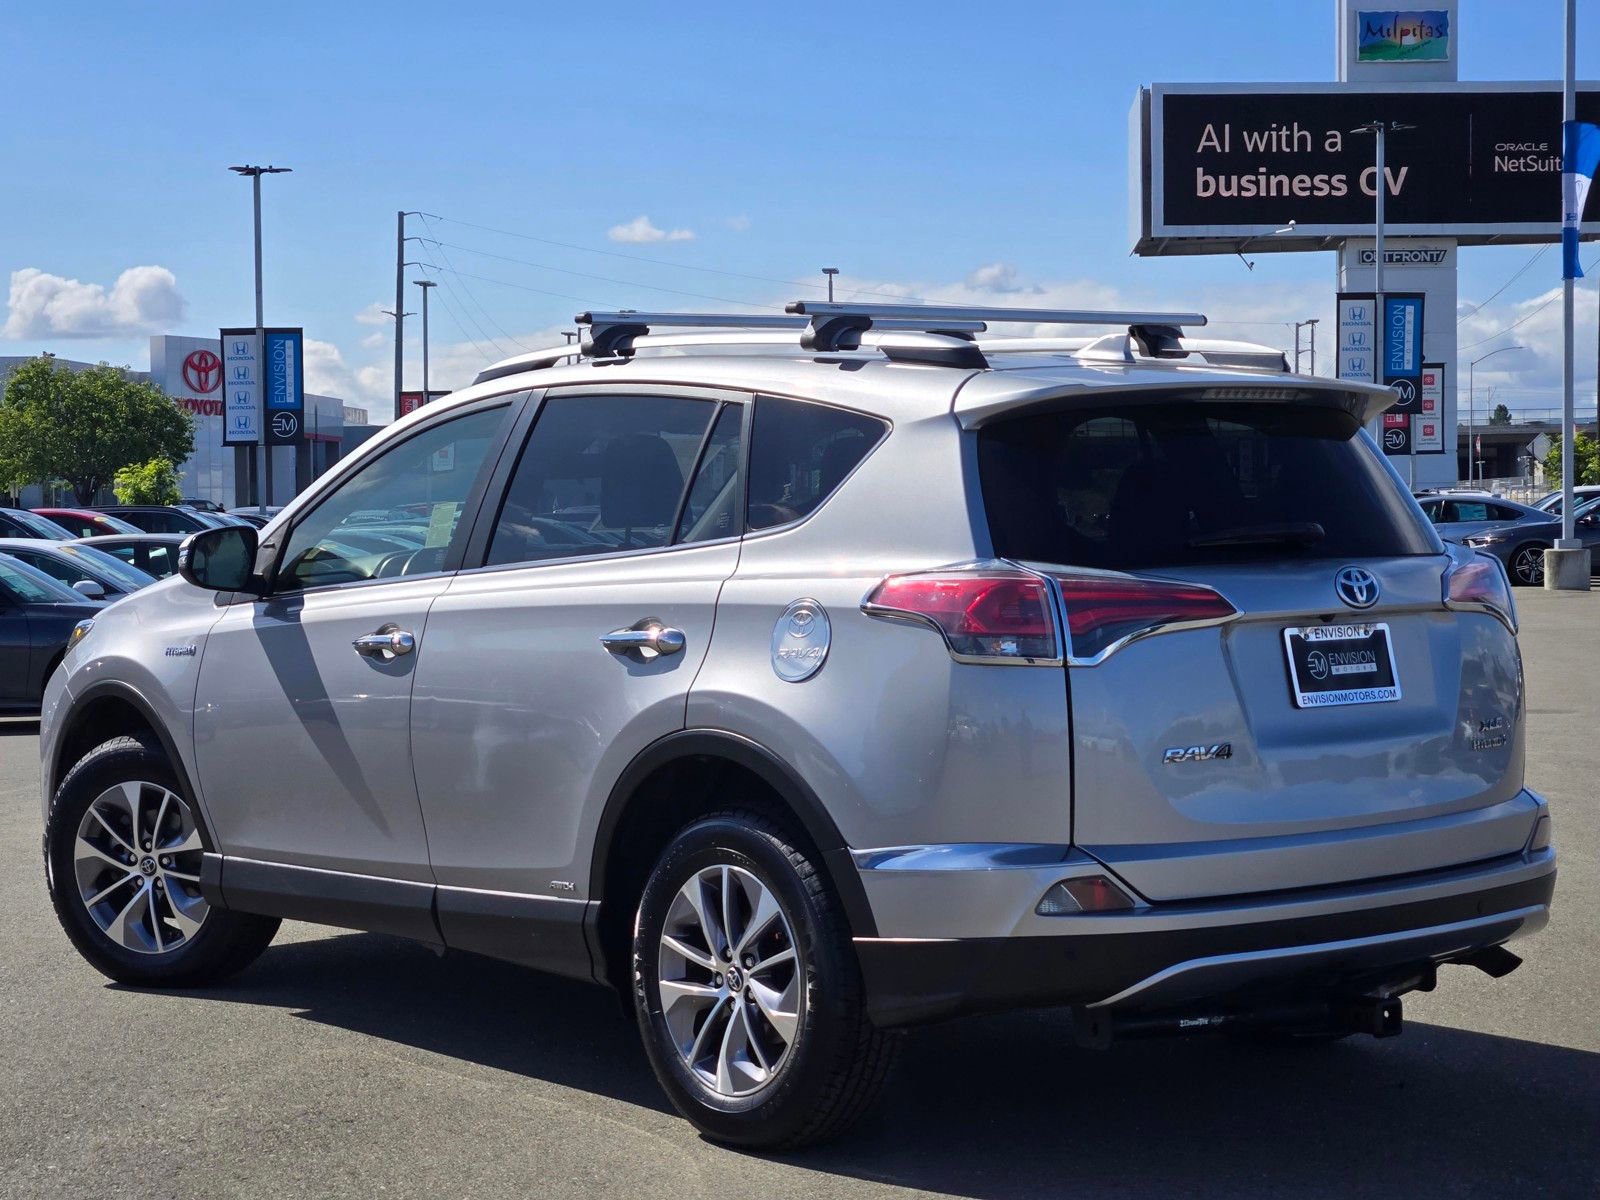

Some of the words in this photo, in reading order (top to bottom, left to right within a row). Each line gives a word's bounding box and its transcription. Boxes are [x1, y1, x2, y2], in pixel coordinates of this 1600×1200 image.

[1363, 14, 1443, 48] Milpitas
[1196, 123, 1230, 153] AI
[1242, 122, 1312, 153] with
[1324, 130, 1342, 152] a
[1494, 143, 1548, 151] ORACLE
[1494, 155, 1564, 172] NetSuit
[1196, 167, 1348, 197] business
[1359, 166, 1409, 197] CV
[1392, 305, 1405, 370] ENVISION
[274, 339, 286, 403] ENVISION
[175, 397, 223, 416] TOYOT
[1314, 626, 1361, 639] ENVISION
[1328, 651, 1376, 665] ENVISION
[1302, 689, 1397, 705] ENVISIONMOTORS.COM
[1162, 742, 1233, 763] RAV4
